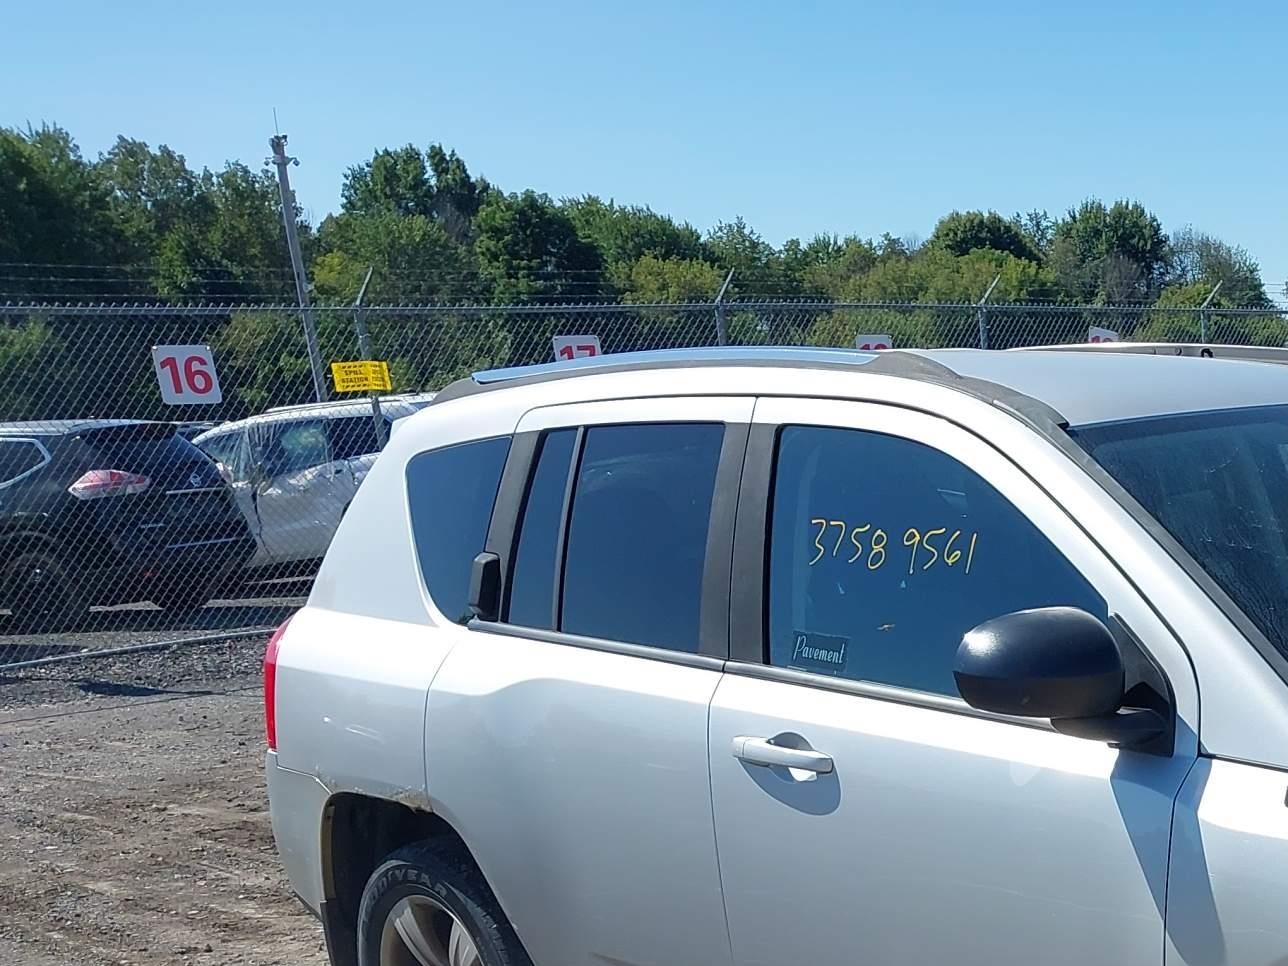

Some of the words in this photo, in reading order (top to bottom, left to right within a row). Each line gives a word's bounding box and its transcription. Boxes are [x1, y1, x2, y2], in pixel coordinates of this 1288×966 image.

[160, 355, 213, 394] 16
[808, 518, 888, 570] 3758
[903, 527, 978, 575] 9561
[793, 635, 846, 664] Pavement
